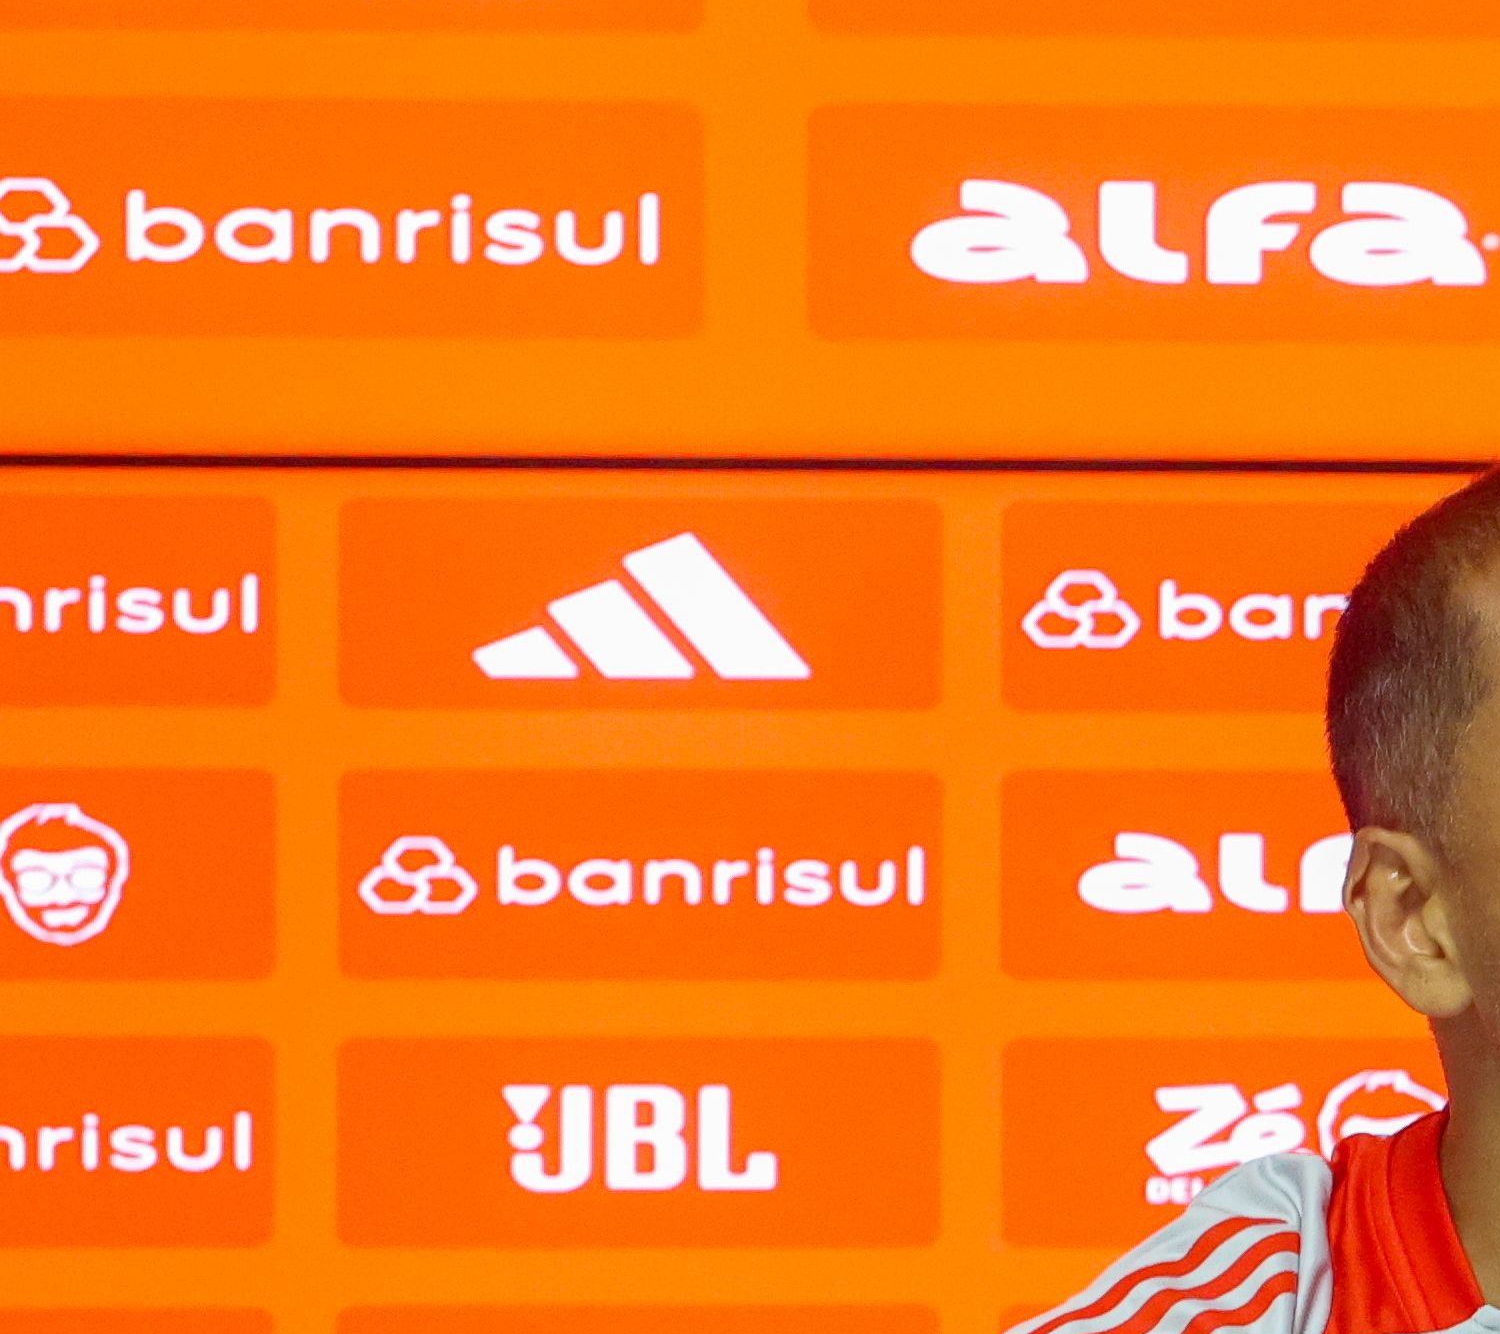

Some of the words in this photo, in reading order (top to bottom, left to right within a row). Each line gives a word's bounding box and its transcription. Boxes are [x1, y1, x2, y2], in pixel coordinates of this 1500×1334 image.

[126, 190, 660, 265] banrisul
[911, 179, 1500, 287] alfa
[0, 574, 258, 634] nrisul
[498, 846, 925, 906] banrisul
[0, 1112, 252, 1172] nrisul
